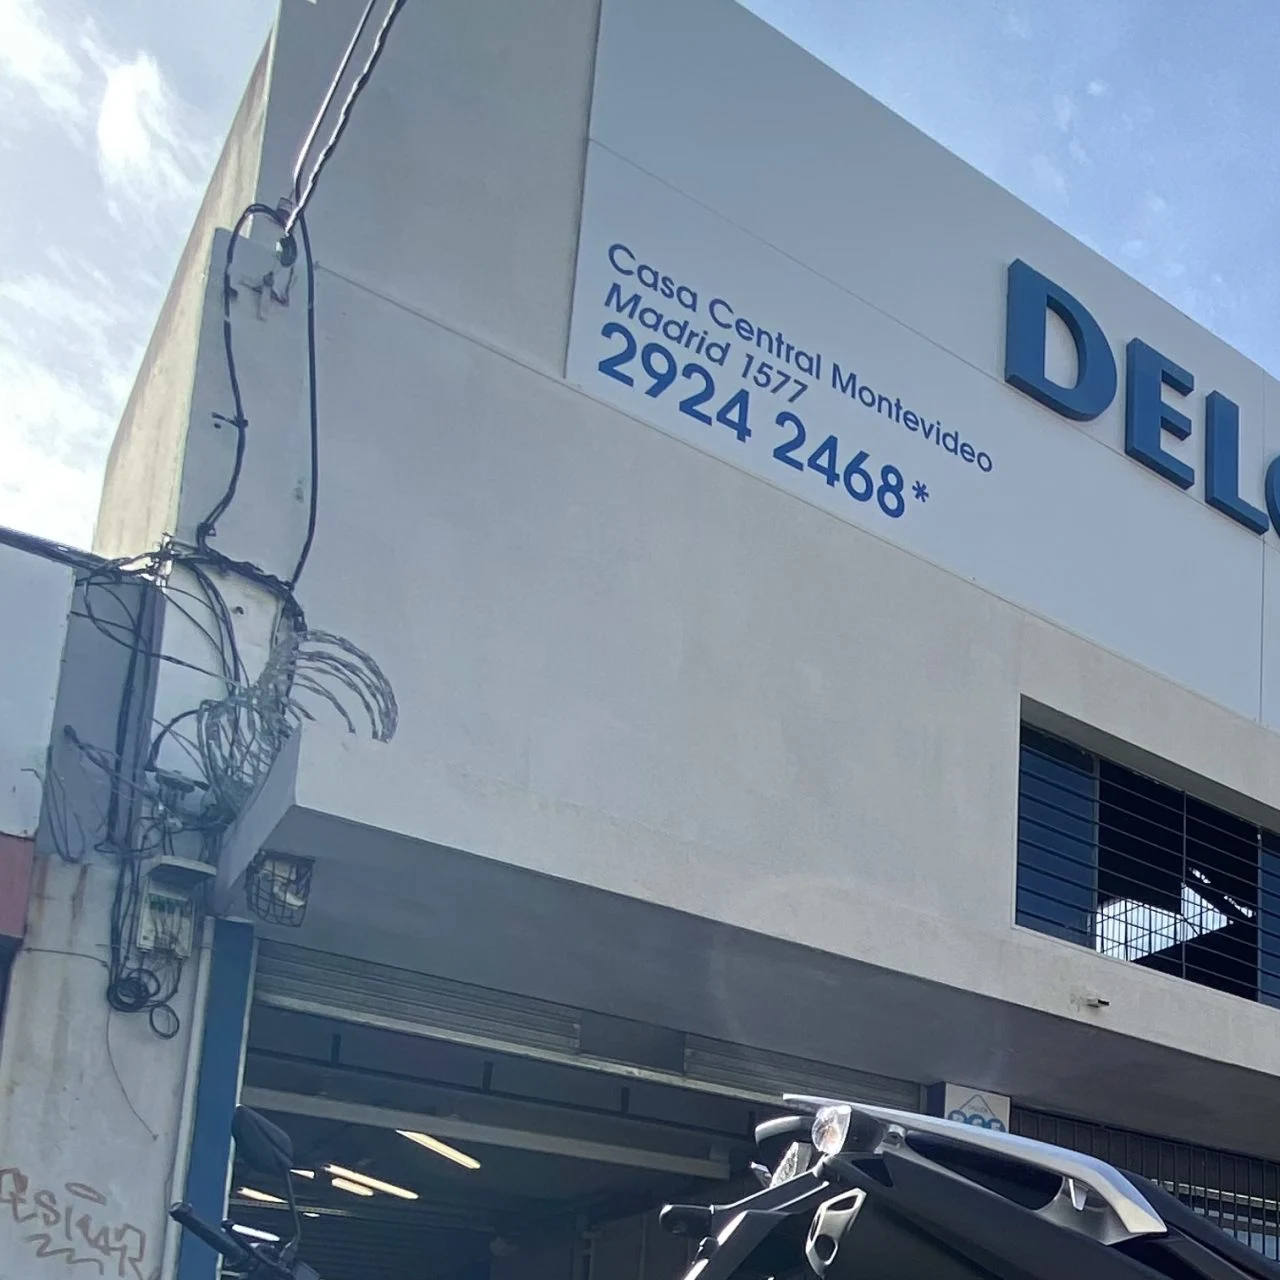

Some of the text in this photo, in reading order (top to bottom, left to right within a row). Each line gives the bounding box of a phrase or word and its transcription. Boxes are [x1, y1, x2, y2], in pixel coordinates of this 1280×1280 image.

[598, 322, 752, 443] 2924
[604, 282, 809, 404] Madrid 1577
[607, 243, 993, 473] Casa Central Montevideo
